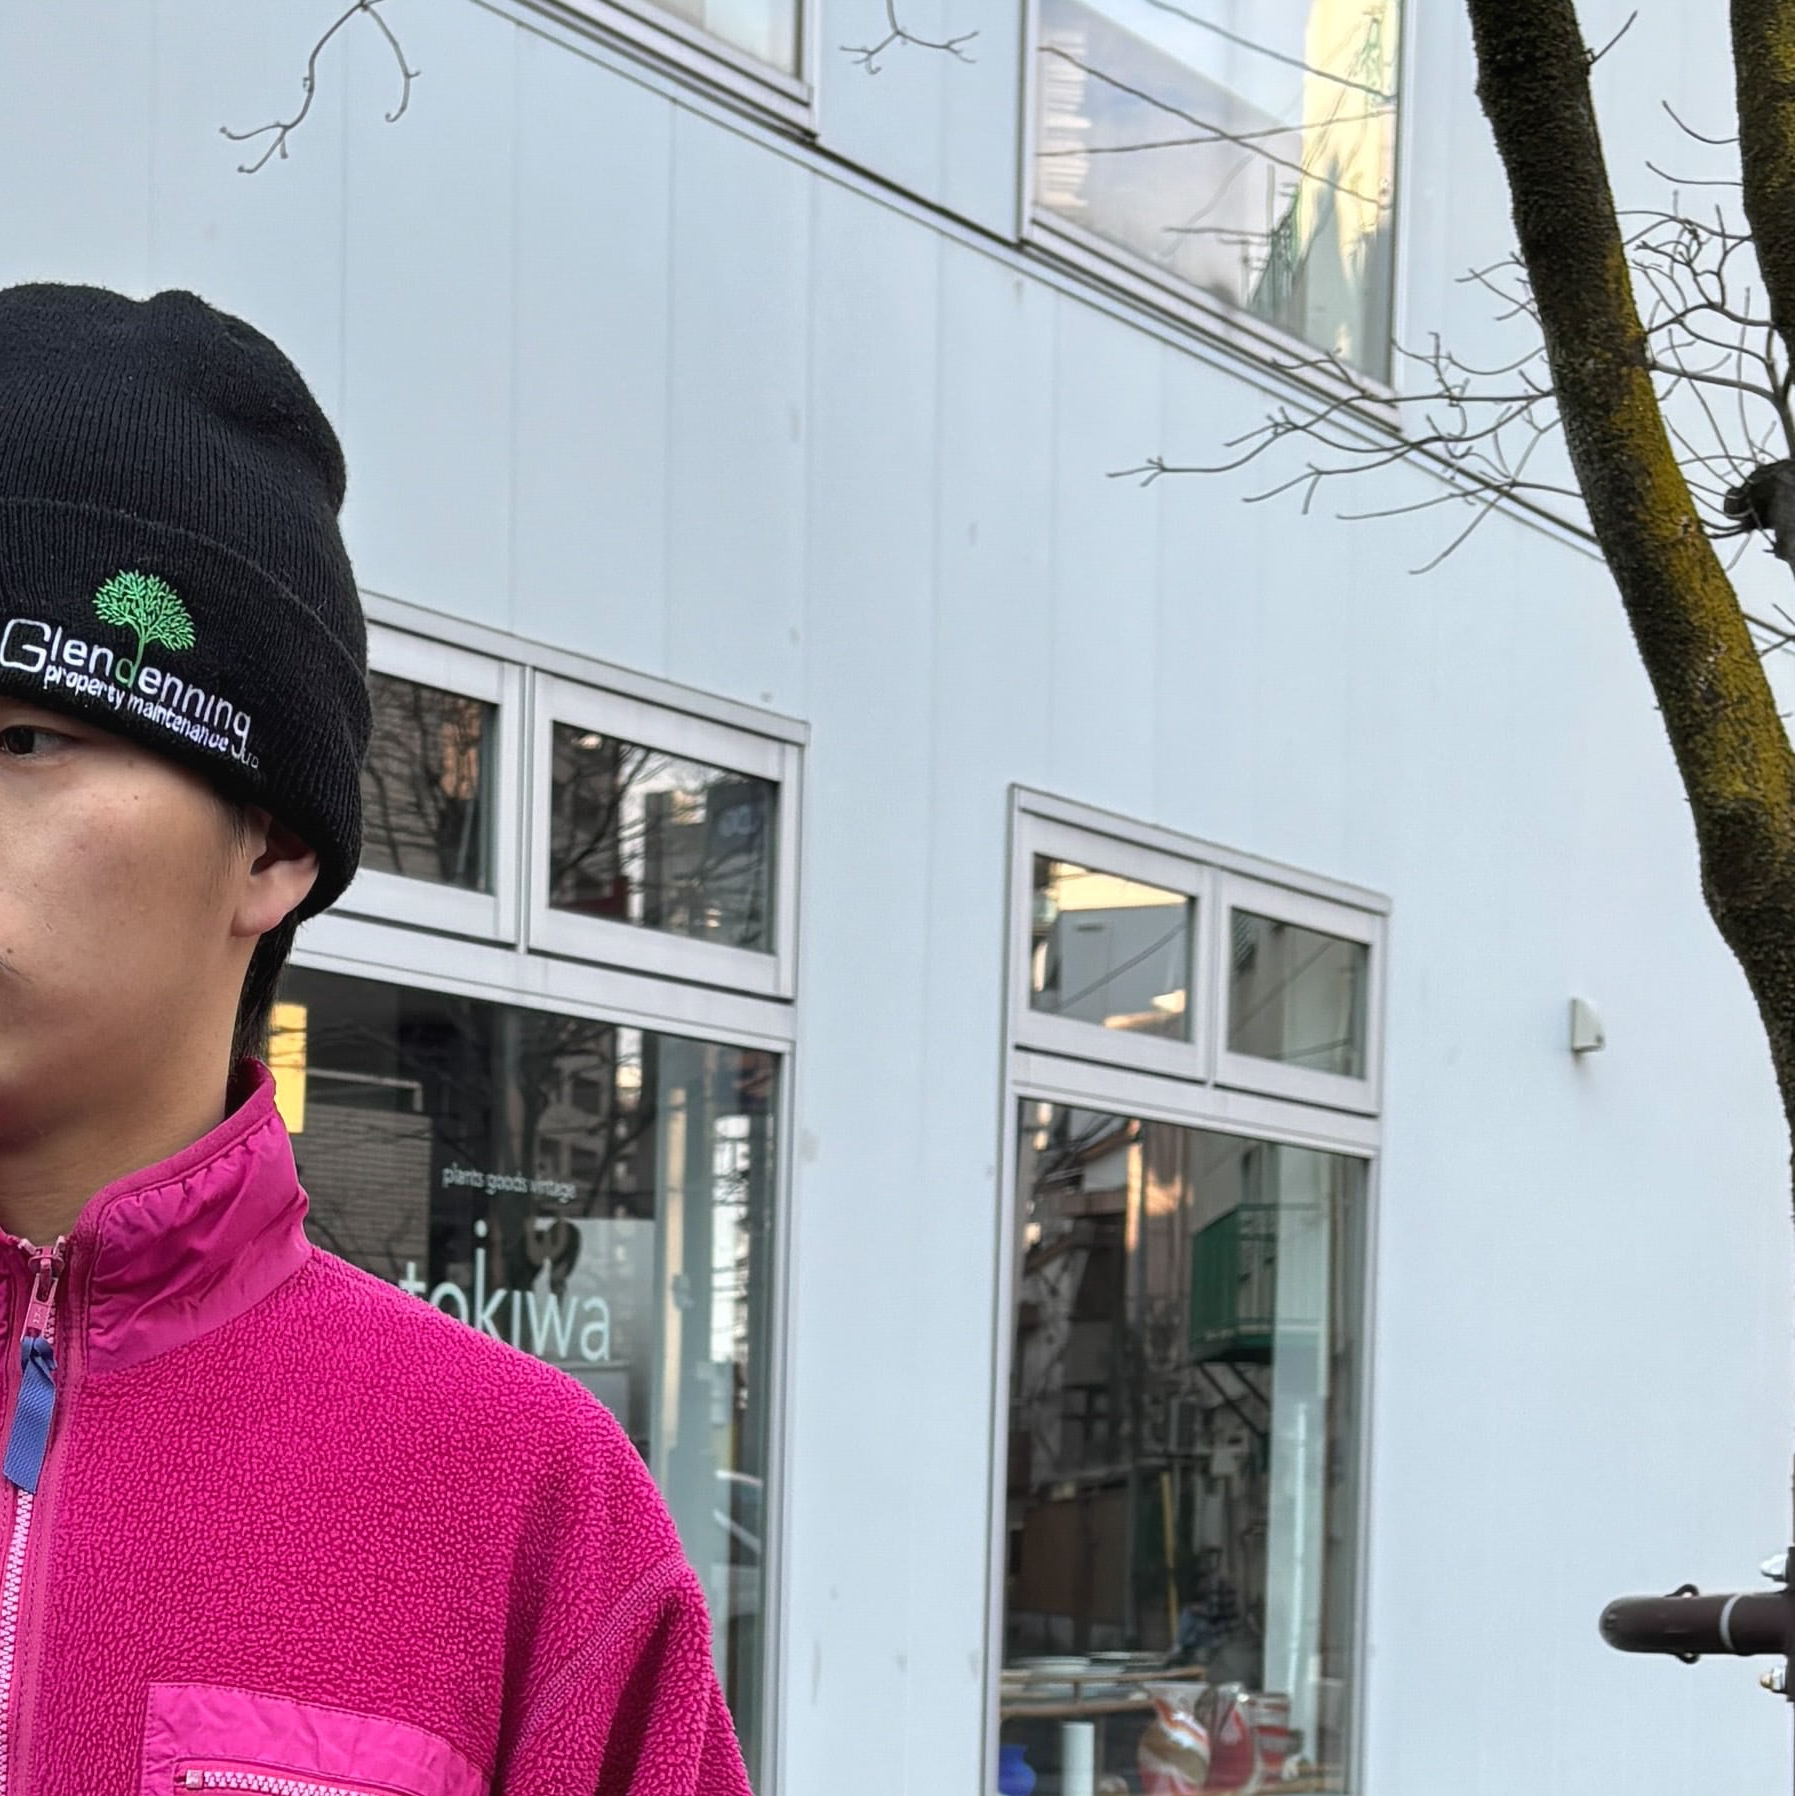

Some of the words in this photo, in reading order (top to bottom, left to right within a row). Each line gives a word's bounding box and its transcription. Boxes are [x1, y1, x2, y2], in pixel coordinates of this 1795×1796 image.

[0, 618, 251, 760] Glendenning
[43, 664, 125, 710] property
[442, 1162, 484, 1189] plants
[485, 1171, 528, 1195] goods
[530, 1174, 576, 1204] vintage
